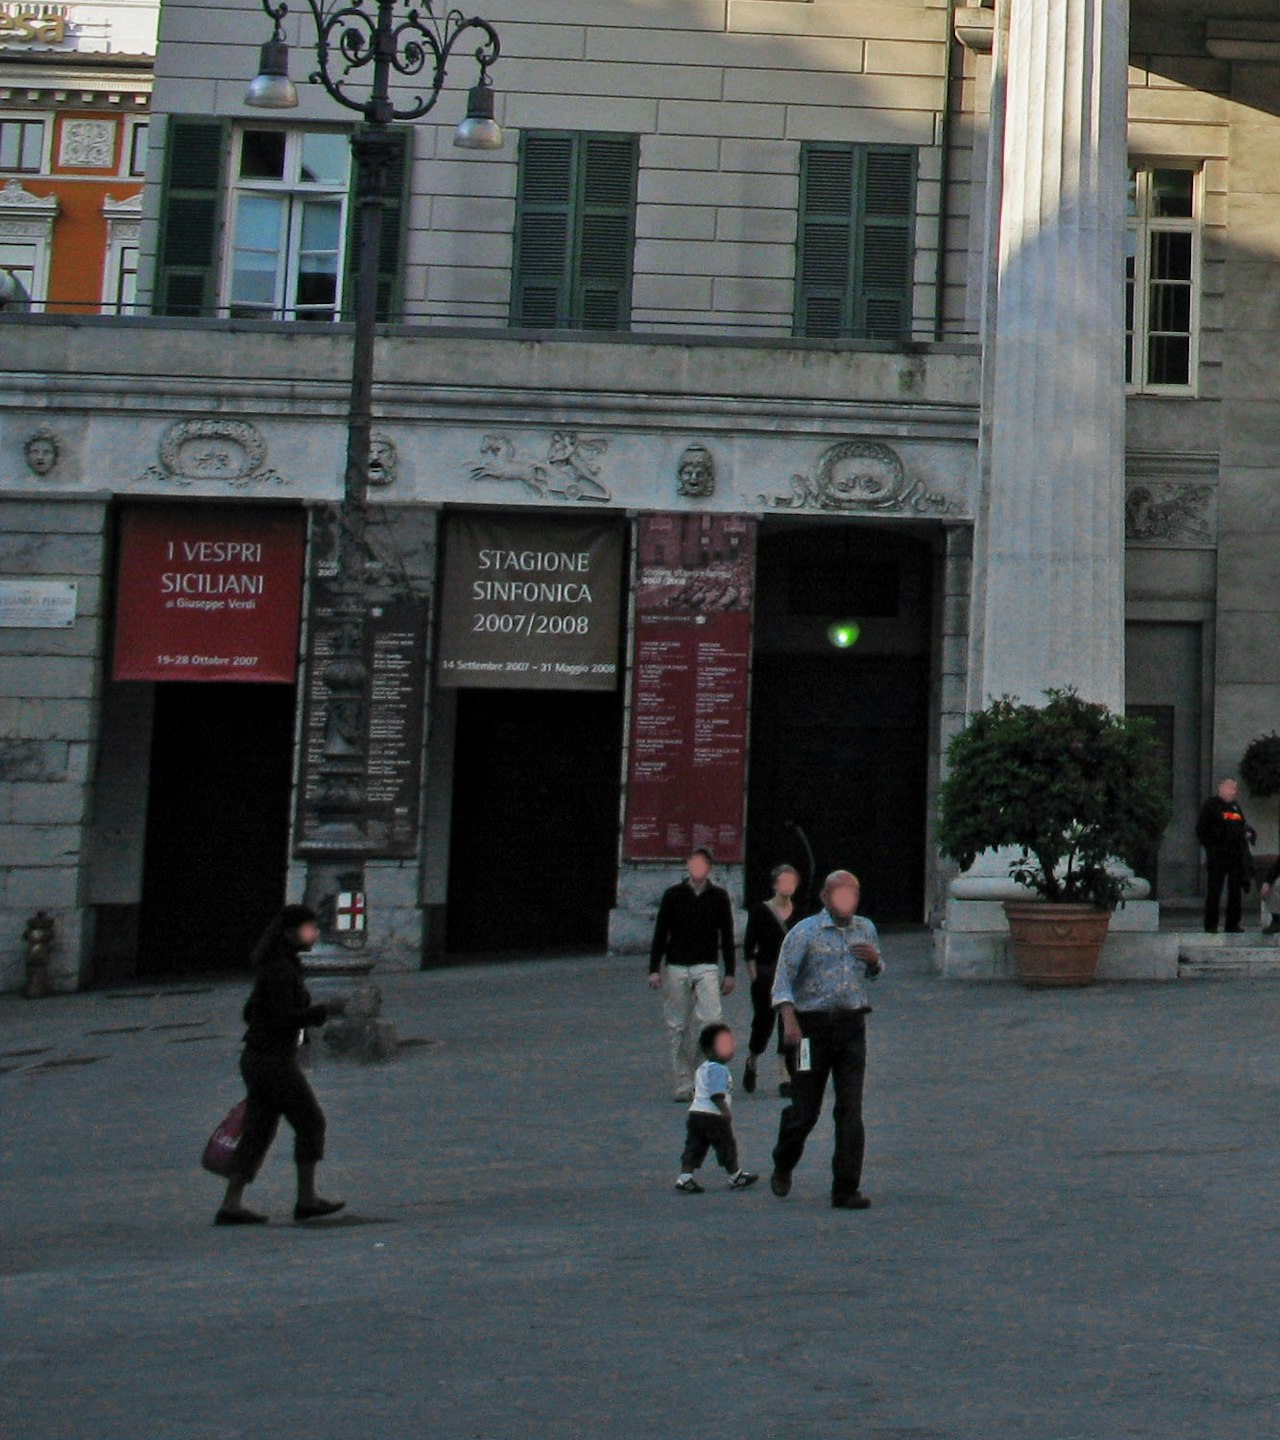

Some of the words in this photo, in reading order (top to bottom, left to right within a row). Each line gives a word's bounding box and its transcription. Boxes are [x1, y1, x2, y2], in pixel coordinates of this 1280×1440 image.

[168, 541, 174, 561] I
[183, 541, 262, 562] VESPRI
[478, 549, 591, 572] STAGIONE
[161, 572, 264, 594] SICILIANI
[472, 580, 593, 603] SINFONICA
[177, 598, 225, 611] Giuseppe
[228, 599, 257, 609] Verdi
[472, 612, 589, 637] 2007/2008
[191, 655, 230, 665] Ottobre
[232, 656, 259, 666] 2007
[443, 660, 455, 669] 14
[457, 661, 503, 671] Settembre
[506, 662, 530, 672] 2007
[541, 664, 552, 673] 31
[556, 664, 589, 676] Maggio
[592, 664, 616, 674] 2008
